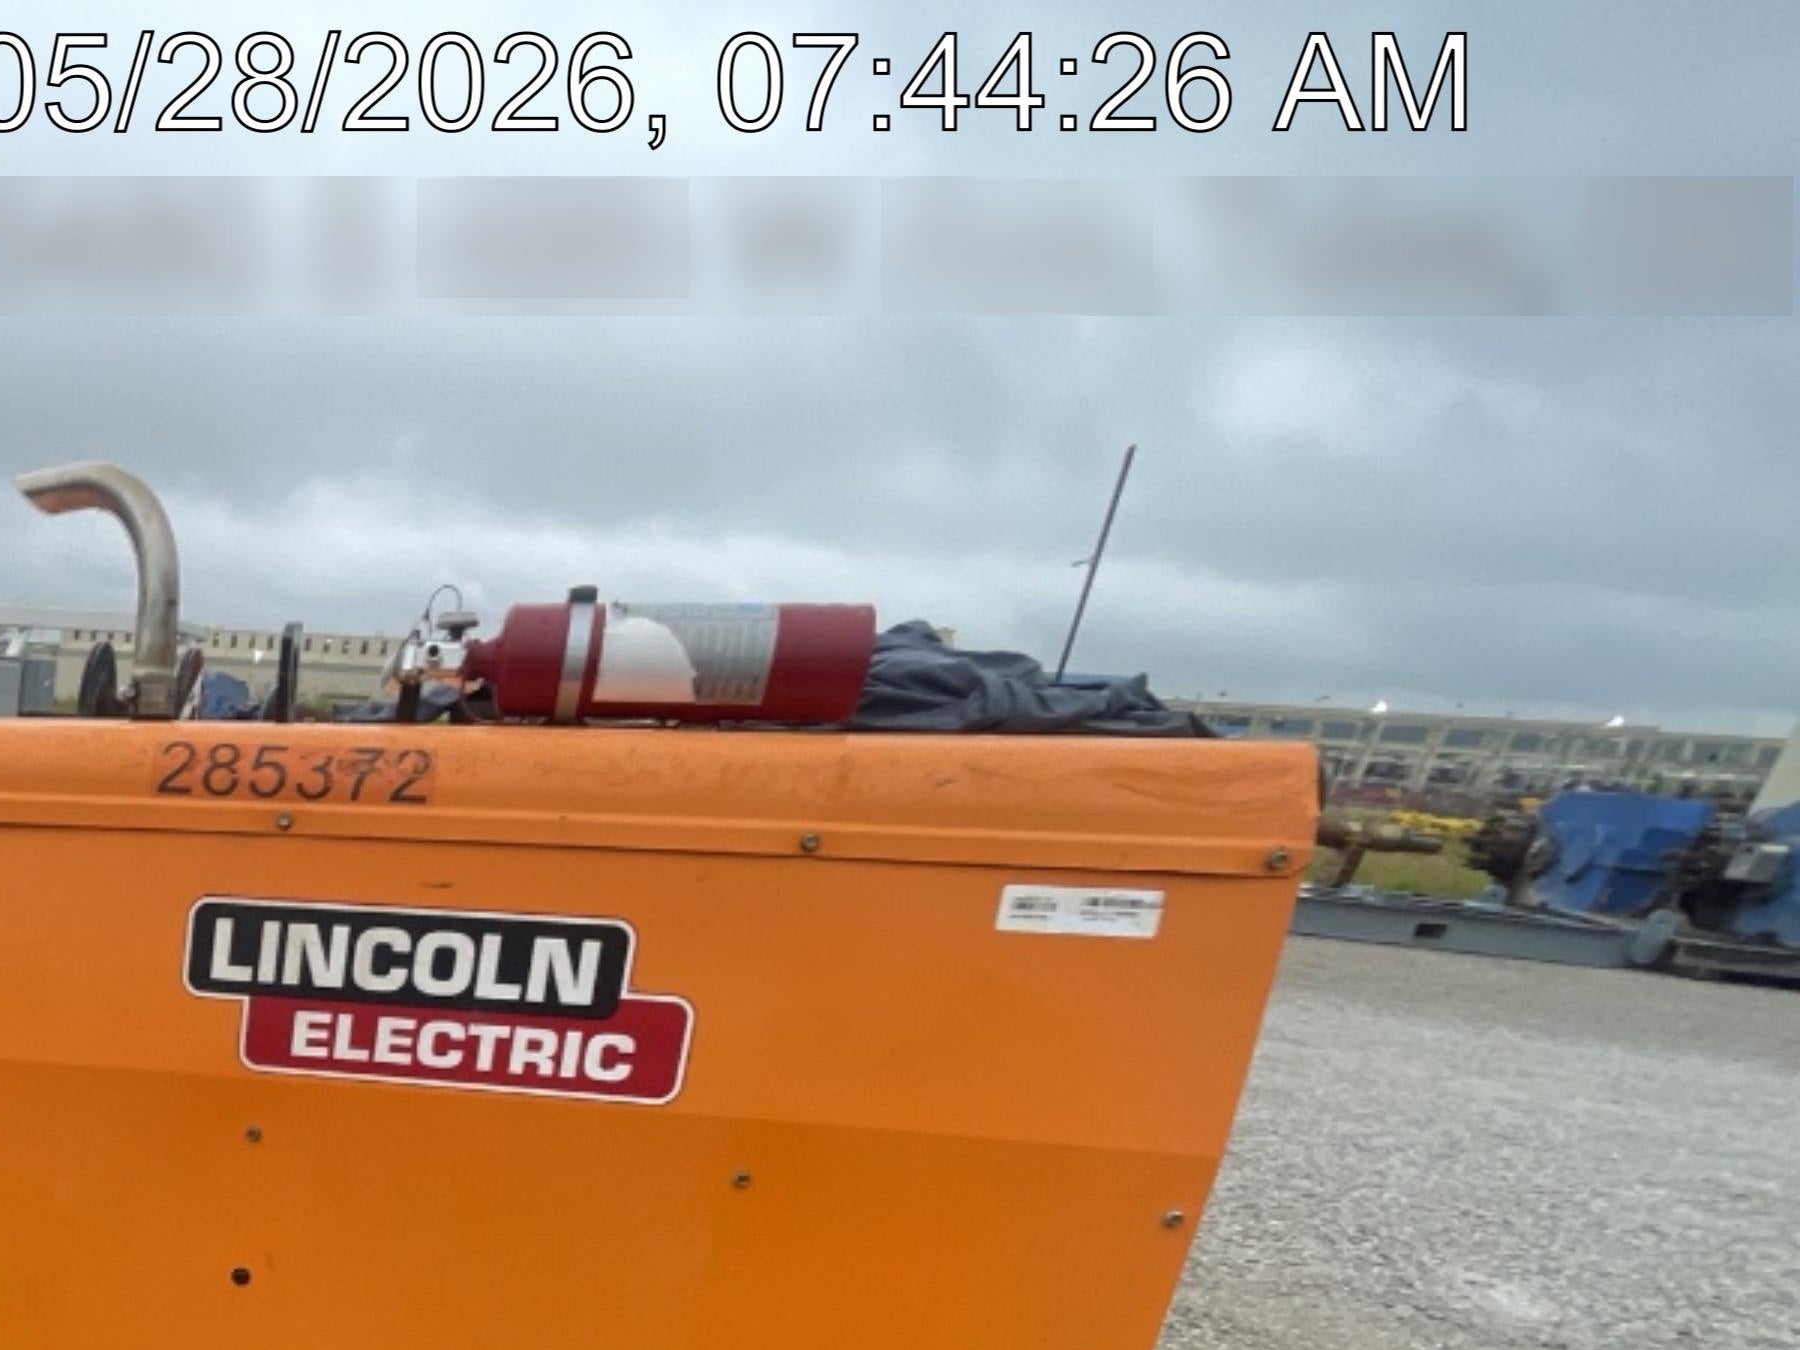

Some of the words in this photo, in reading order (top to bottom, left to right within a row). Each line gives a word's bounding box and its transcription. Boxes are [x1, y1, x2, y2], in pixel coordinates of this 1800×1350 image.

[156, 740, 432, 805] 285372
[208, 916, 604, 1008] LINCOLN
[289, 1009, 637, 1083] ELECTRIC
